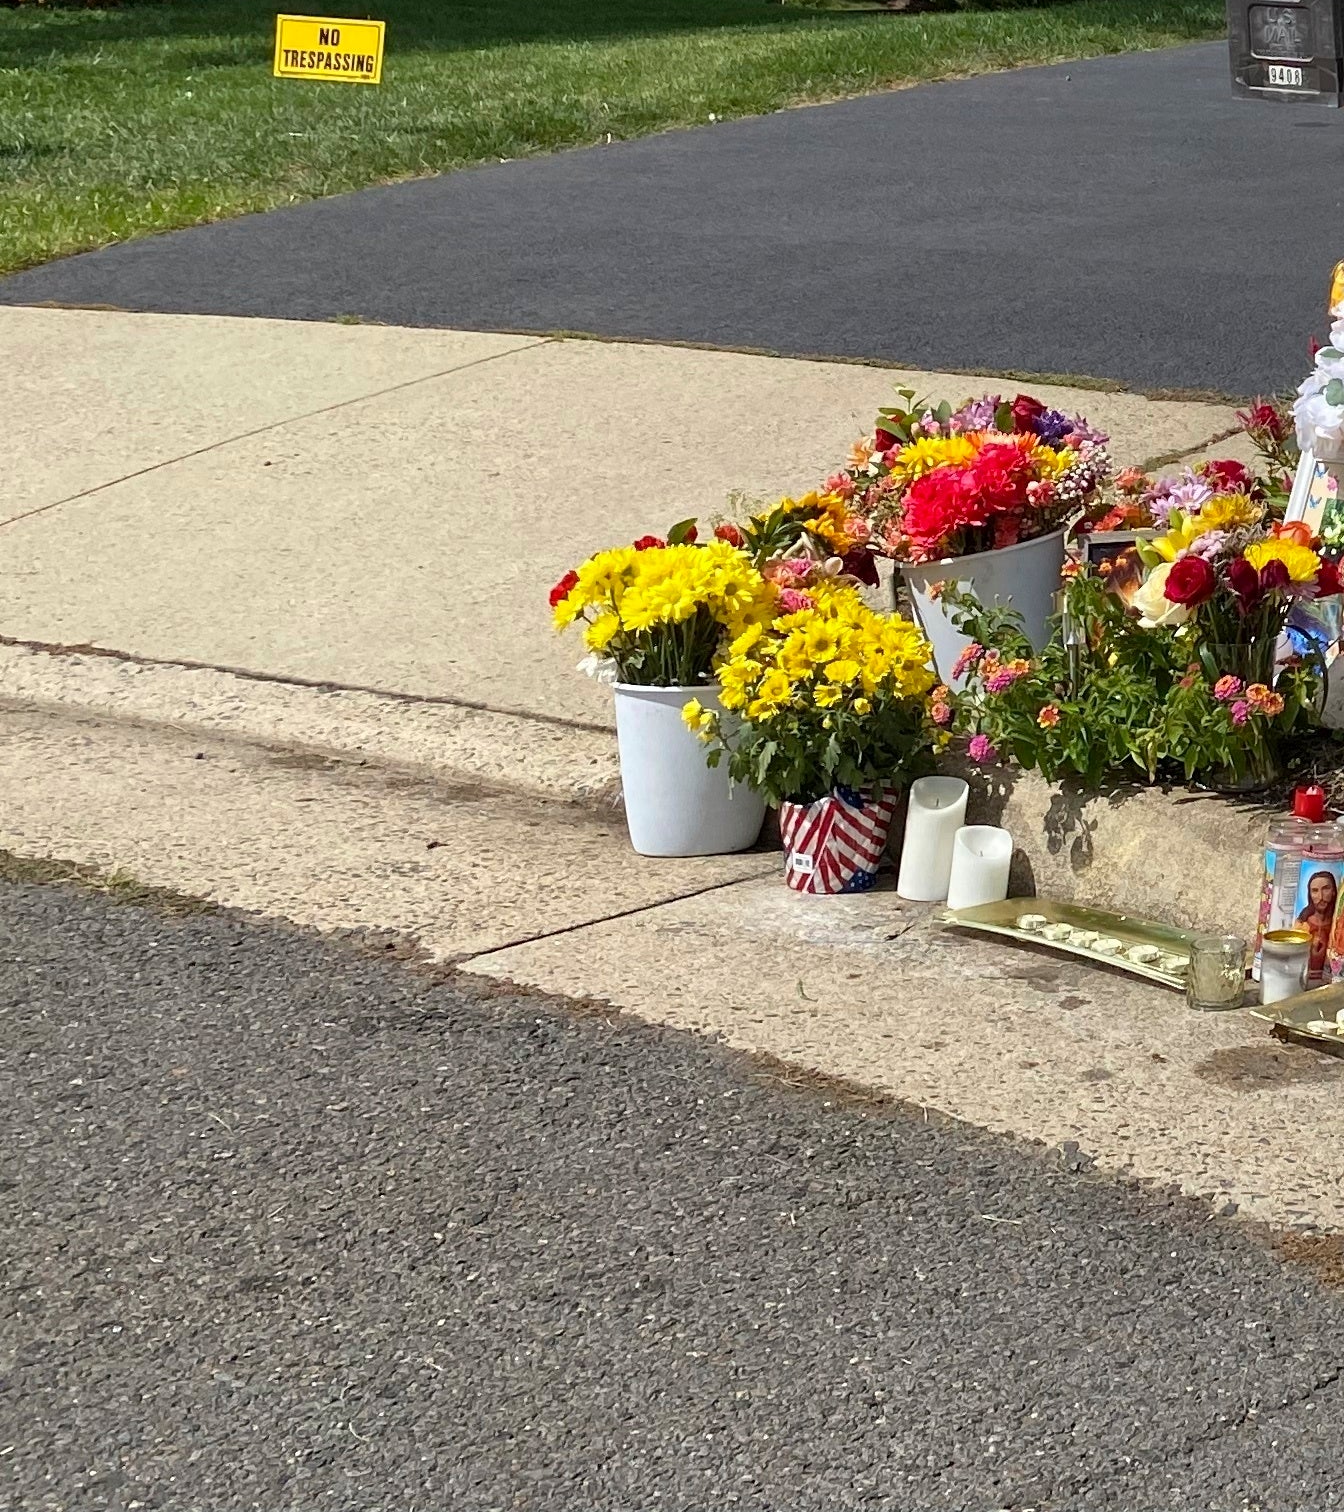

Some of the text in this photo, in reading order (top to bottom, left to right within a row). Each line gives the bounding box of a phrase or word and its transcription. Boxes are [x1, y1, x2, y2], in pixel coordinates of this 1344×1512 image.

[318, 27, 341, 46] NO
[283, 49, 375, 73] TRESPASSING
[1271, 67, 1301, 85] 9408
